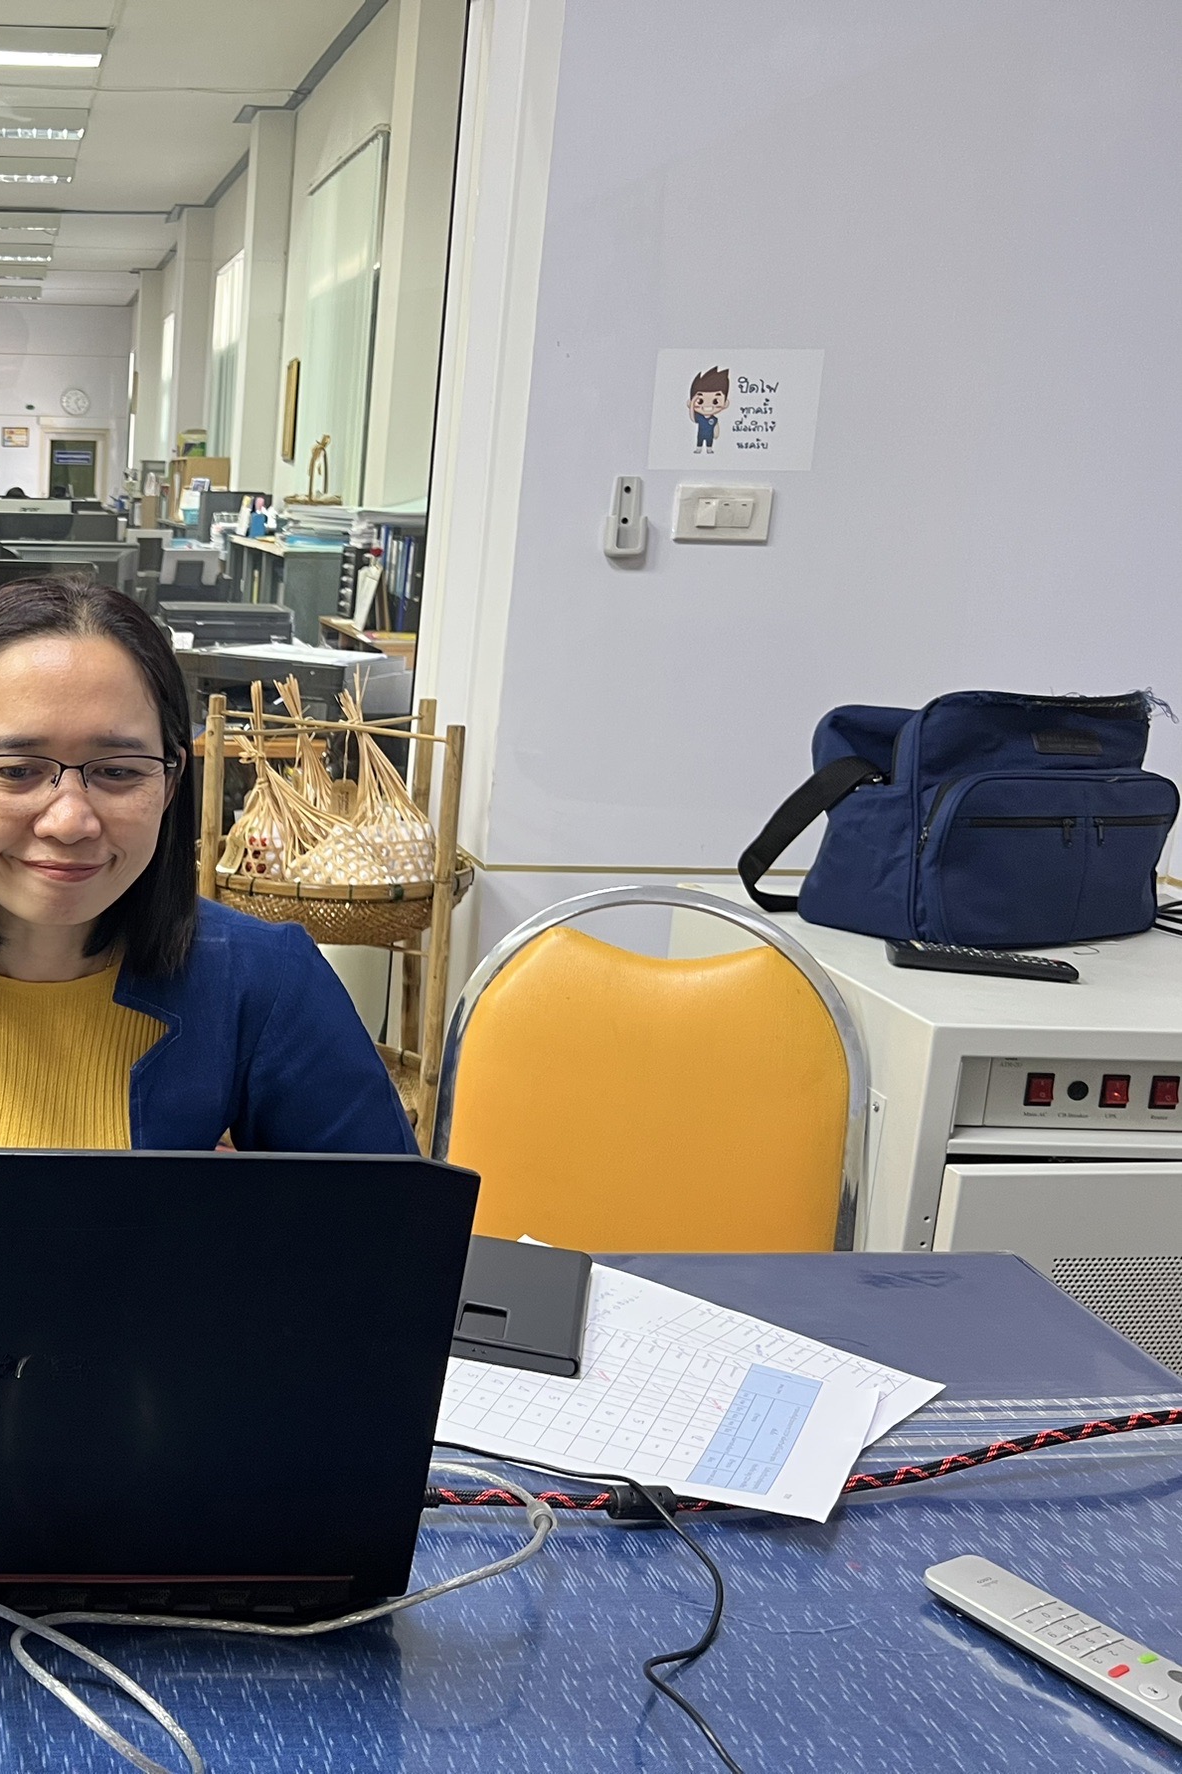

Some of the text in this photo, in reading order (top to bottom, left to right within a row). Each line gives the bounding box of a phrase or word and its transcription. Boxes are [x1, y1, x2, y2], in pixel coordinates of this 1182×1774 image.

[737, 376, 779, 394] ปิดไฟ
[739, 398, 773, 418] ทุกครั้ง
[732, 418, 776, 432] เมื่อเลิกใช้
[736, 438, 769, 449] นะครับ
